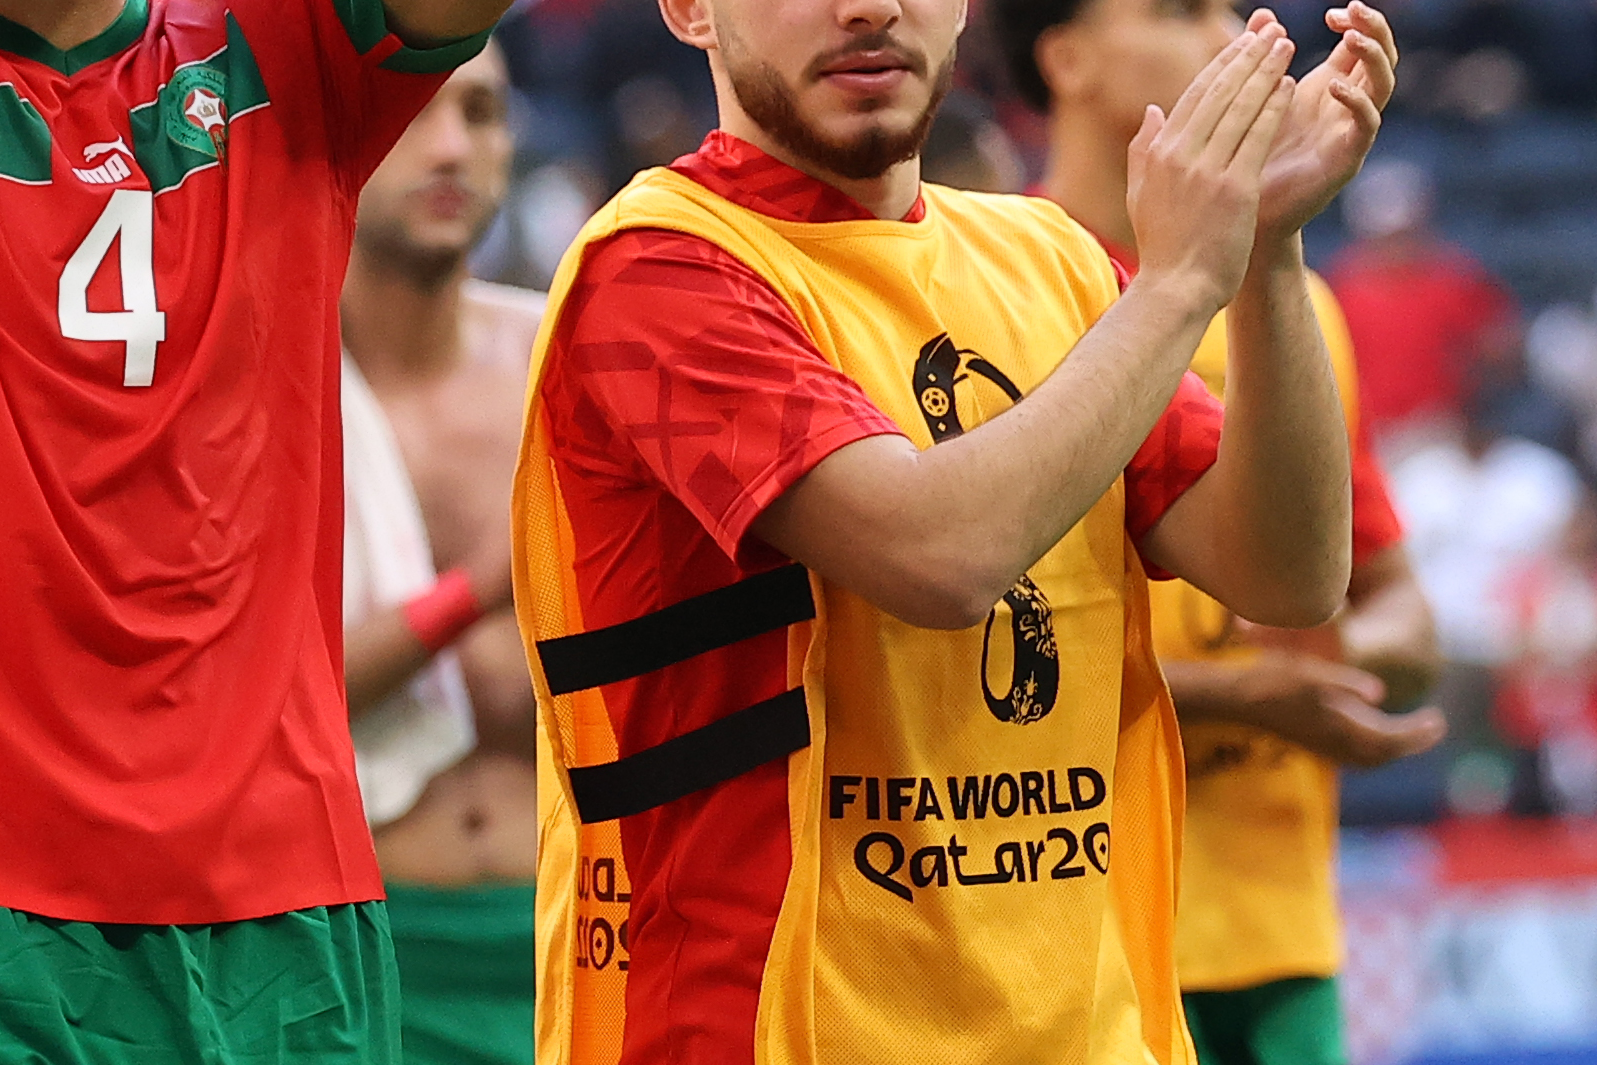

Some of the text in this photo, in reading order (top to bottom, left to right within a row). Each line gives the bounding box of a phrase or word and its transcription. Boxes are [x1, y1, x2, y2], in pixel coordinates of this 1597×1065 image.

[58, 189, 166, 386] 4
[830, 767, 1107, 821] FIFA WORLD
